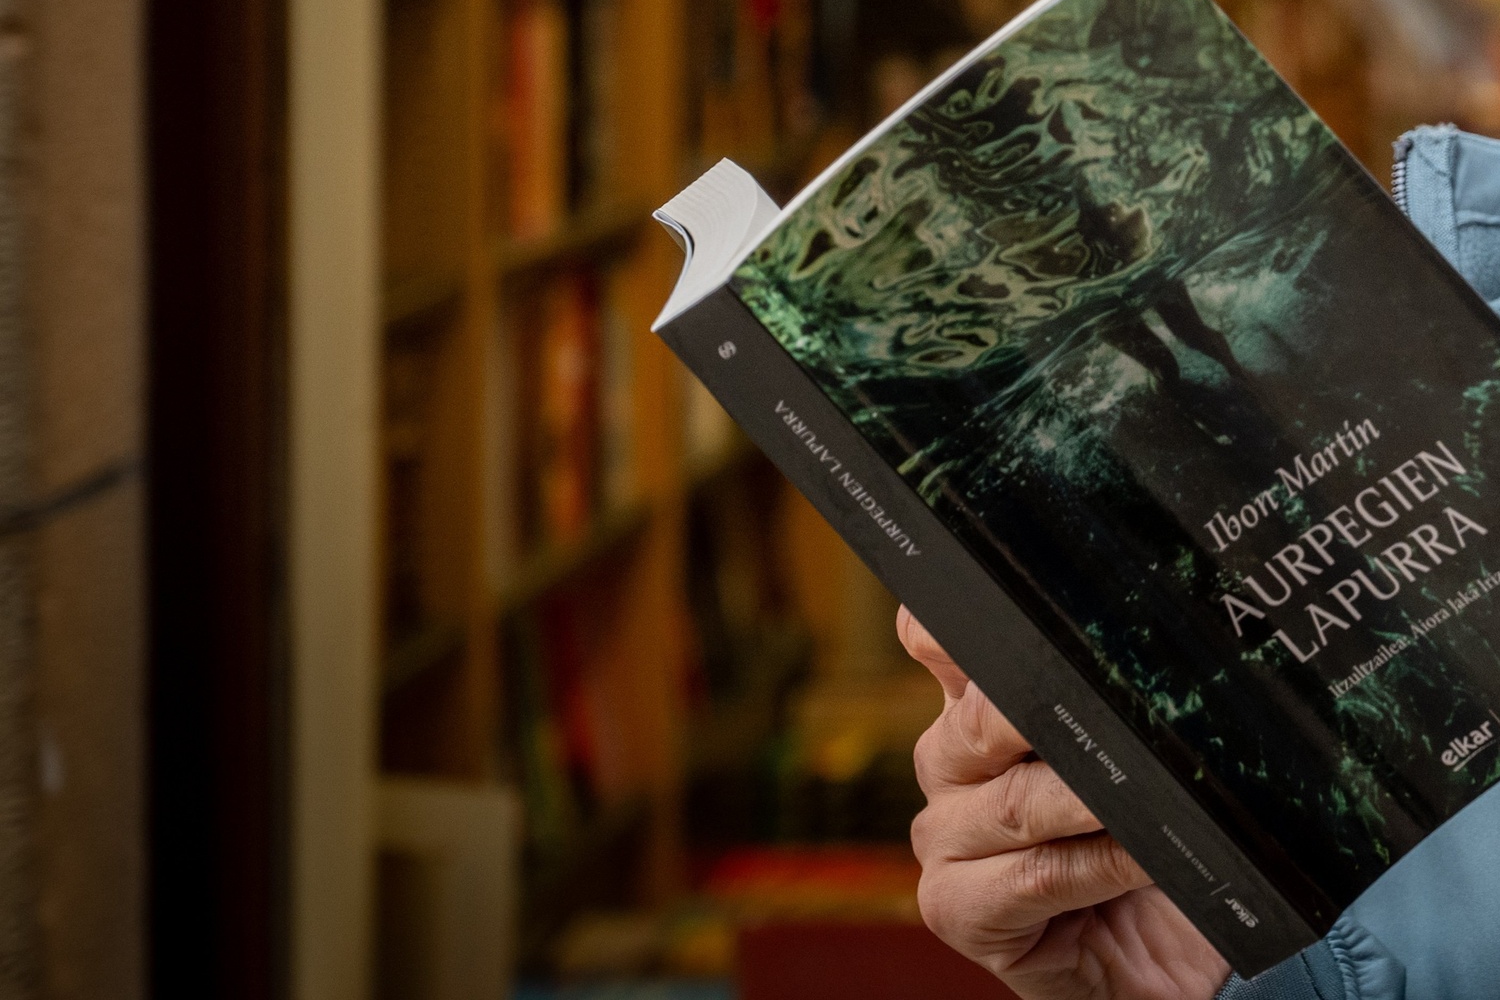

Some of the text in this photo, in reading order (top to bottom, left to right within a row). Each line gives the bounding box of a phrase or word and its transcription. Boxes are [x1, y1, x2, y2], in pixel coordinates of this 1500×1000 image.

[774, 400, 921, 556] AURPEGIEN LAPURRA
[1203, 418, 1380, 552] Ibon Martín
[1220, 440, 1467, 637] AURPEGIEN
[1271, 506, 1488, 663] LAPURRA
[1328, 635, 1411, 698] Itzultzailea:
[1409, 607, 1450, 640] Aiora
[1446, 588, 1480, 614] Jaka
[1096, 750, 1127, 784] Ibon
[1441, 720, 1493, 766] elkar
[1225, 898, 1256, 928] elkar
